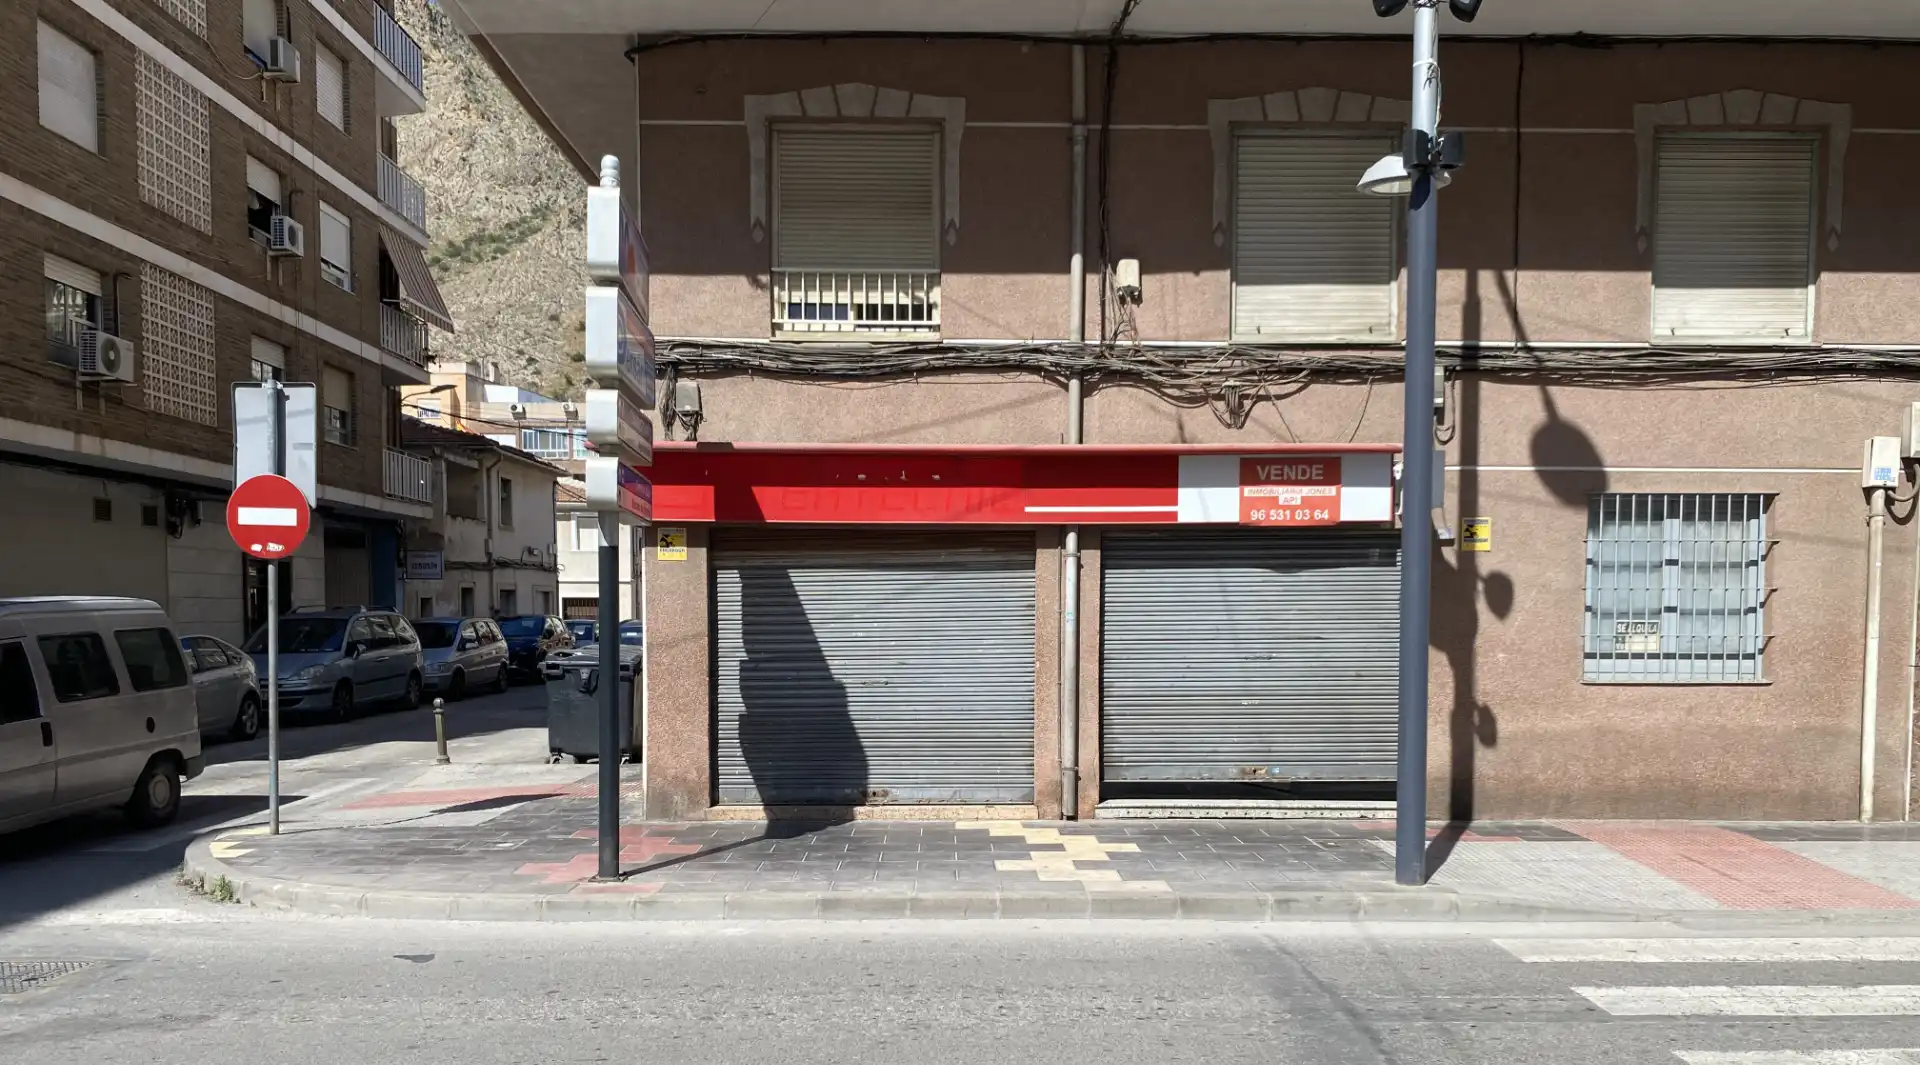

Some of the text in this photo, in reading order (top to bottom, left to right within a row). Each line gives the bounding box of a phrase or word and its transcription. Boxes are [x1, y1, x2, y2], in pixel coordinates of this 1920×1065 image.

[1256, 464, 1324, 481] VENDE
[1306, 488, 1333, 496] JONES
[1250, 509, 1329, 521] 96 531 03 64
[1617, 623, 1657, 633] SE ALQULA
